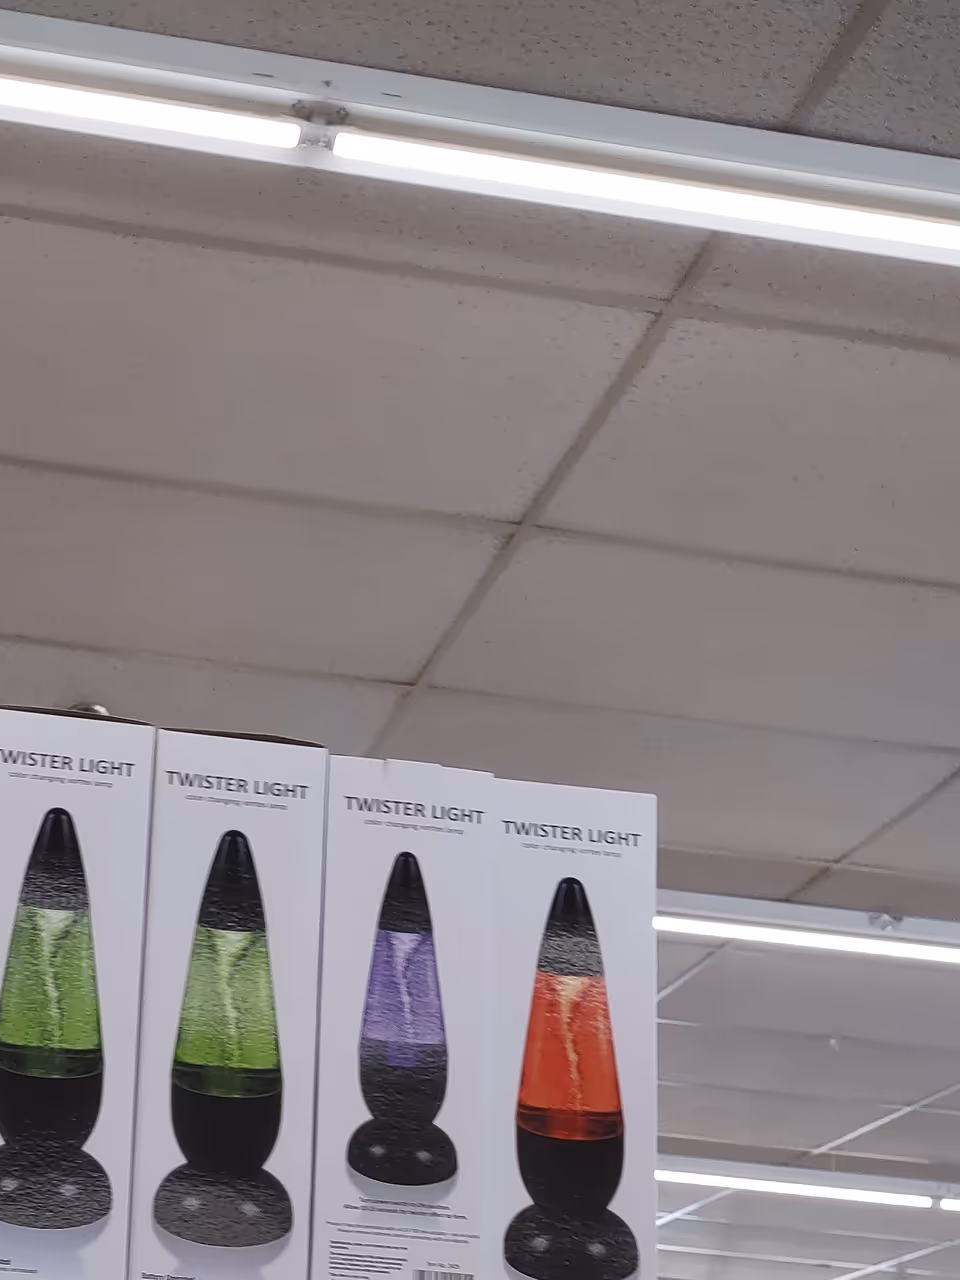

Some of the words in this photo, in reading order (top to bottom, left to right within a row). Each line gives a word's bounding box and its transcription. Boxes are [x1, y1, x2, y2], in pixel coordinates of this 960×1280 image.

[79, 757, 135, 780] LIGHT
[166, 770, 249, 794] TWISTER
[254, 780, 308, 800] LIGHT
[345, 796, 426, 818] TWISTER
[431, 804, 484, 825] LIGHT
[502, 820, 583, 842] TWISTER
[587, 830, 642, 848] LIGHT
